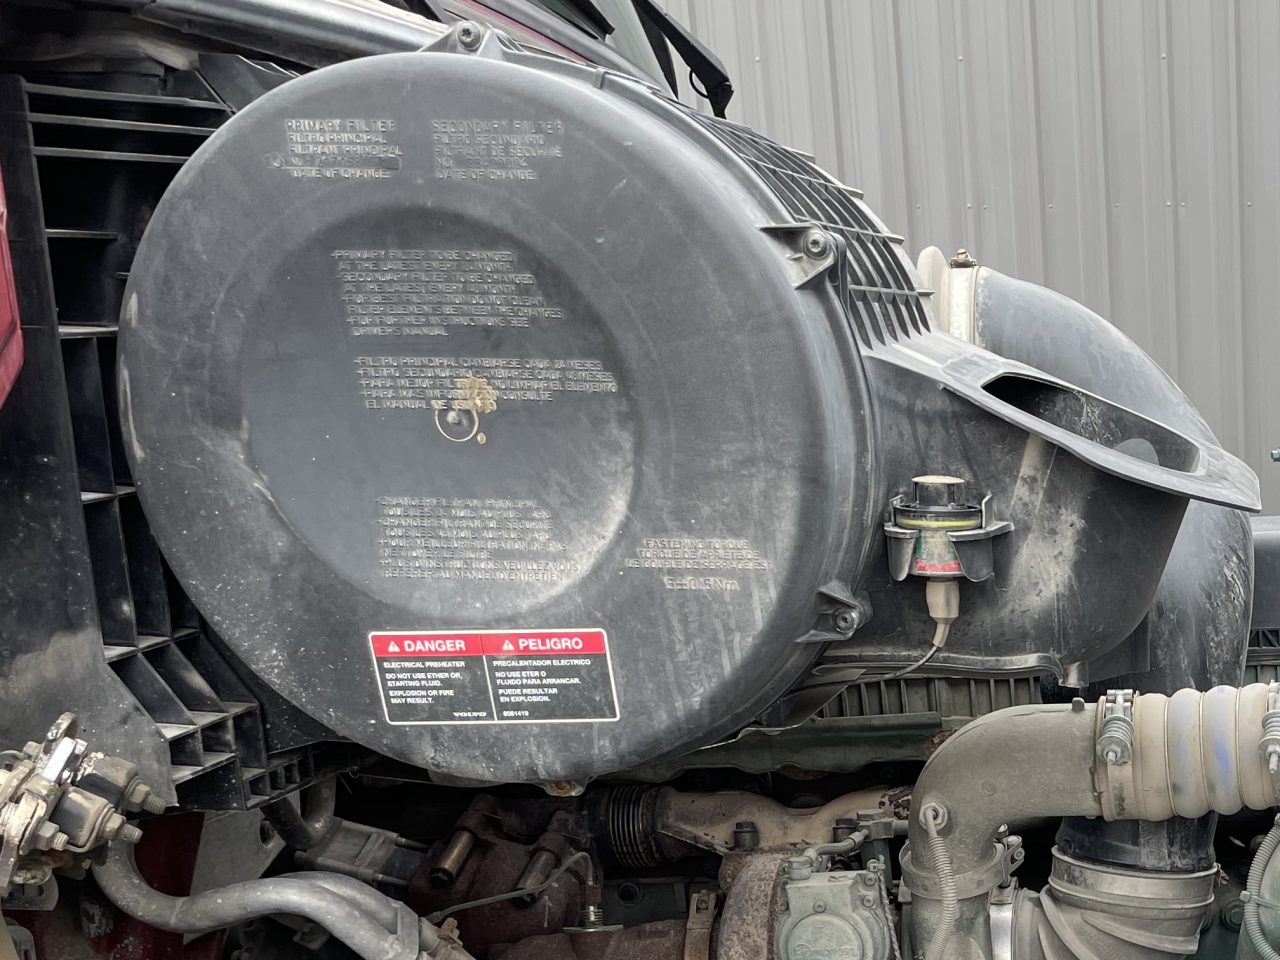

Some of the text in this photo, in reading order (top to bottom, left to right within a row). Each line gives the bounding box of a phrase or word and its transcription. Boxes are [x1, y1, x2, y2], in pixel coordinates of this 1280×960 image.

[287, 119, 397, 133] PRIMARY FILTER
[432, 119, 564, 135] SECONDARY FILTER
[288, 132, 388, 145] FILTRO PRINCIPAL
[433, 133, 472, 145] FILTRO
[292, 168, 323, 180] DATE
[326, 168, 339, 180] OF
[436, 168, 468, 181] DATE
[471, 169, 485, 181] OF
[464, 250, 513, 262] CHANGED
[486, 272, 536, 285] CHANGED
[401, 357, 459, 368] PRINCIPAL
[524, 359, 551, 369] CADA
[569, 360, 603, 371] MESES
[535, 370, 564, 380] CADA
[581, 371, 615, 383] MESES
[551, 381, 564, 391] EL
[566, 381, 618, 393] ELEMENTO
[501, 390, 554, 401] CONSULTE
[366, 399, 380, 409] EL
[383, 399, 430, 409] MANUAL
[645, 539, 751, 551] FASTENING TORQUE
[639, 549, 680, 560] TORQUE
[683, 549, 697, 561] DE
[746, 550, 761, 562] DE
[553, 561, 579, 573] VOUS
[627, 559, 771, 571] LE COUPLE DE SERRAGE EST
[403, 639, 466, 652] DANGER
[518, 637, 583, 650] PELIGRO
[383, 660, 466, 669] ELECTRICAL PREHEATER
[522, 678, 541, 686] PARA
[542, 677, 582, 685] ARRANCAR.
[522, 687, 558, 695] RESULTAR
